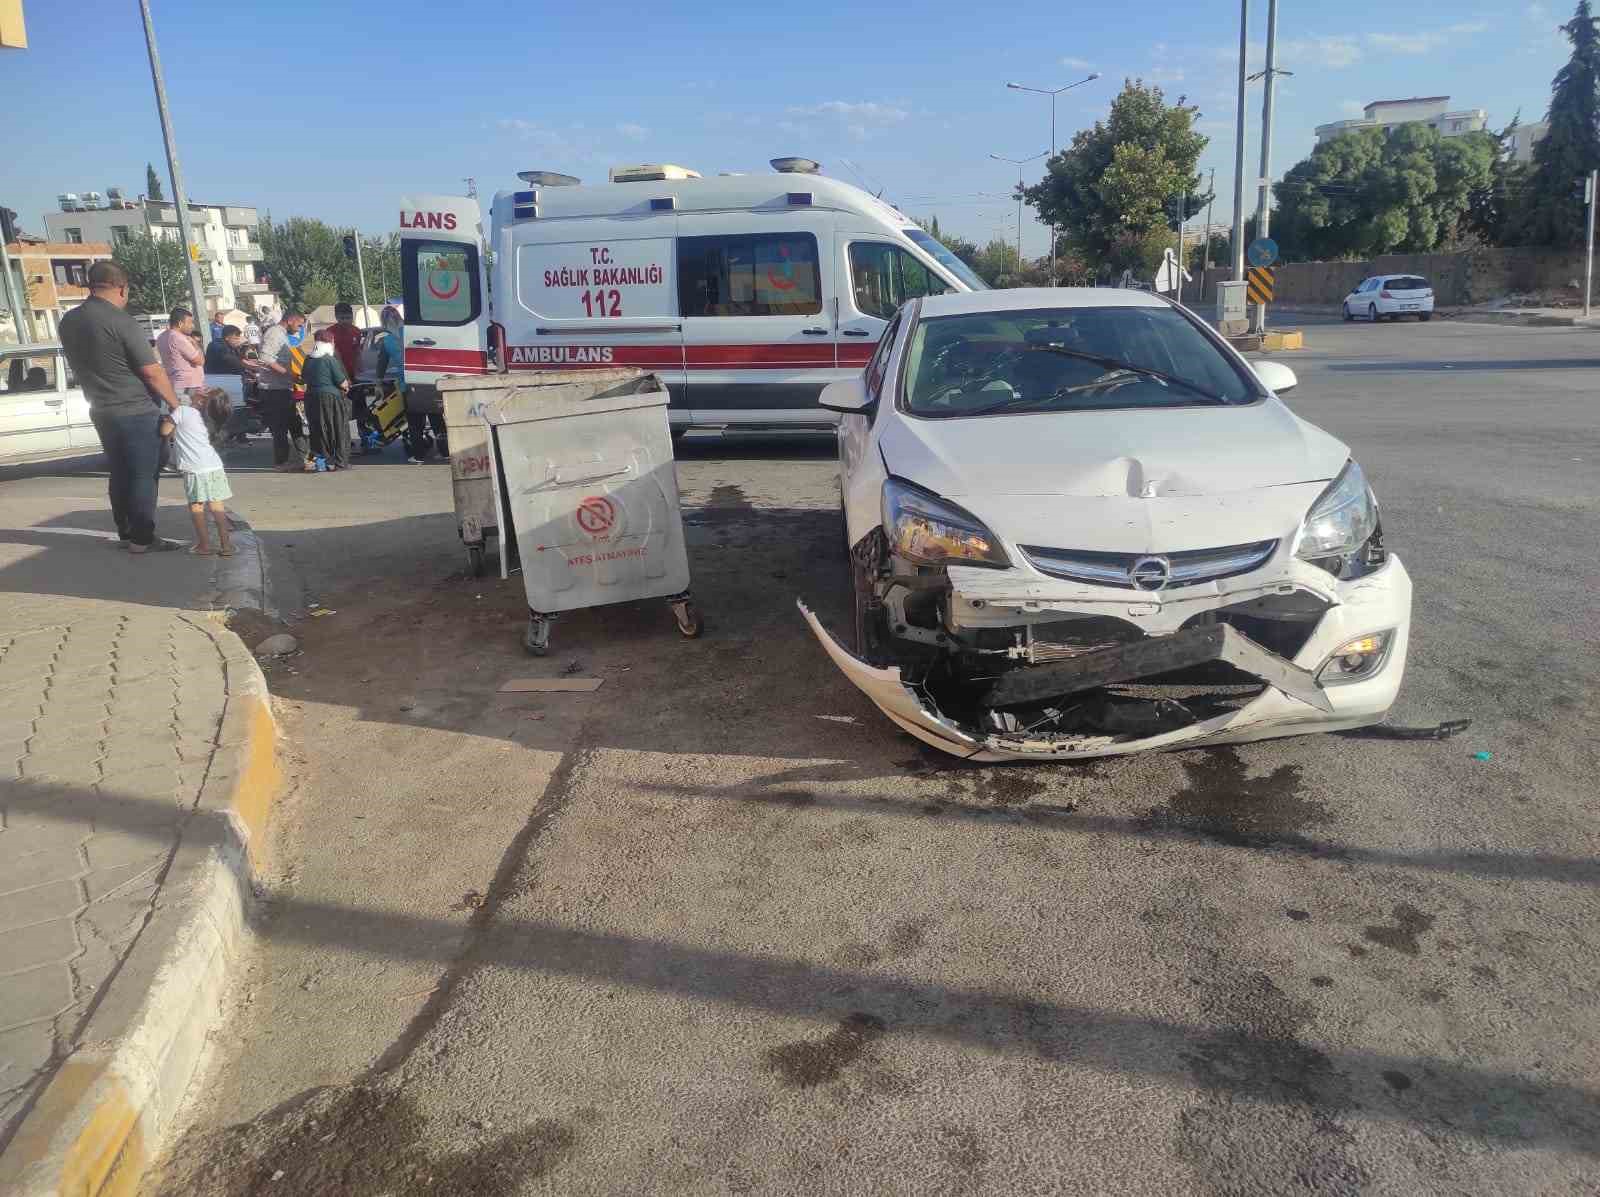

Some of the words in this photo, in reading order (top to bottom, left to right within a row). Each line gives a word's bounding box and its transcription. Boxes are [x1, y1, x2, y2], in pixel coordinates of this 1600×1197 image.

[400, 210, 457, 231] LANS
[590, 247, 614, 265] T.C.
[544, 266, 589, 287] SAĞLIK
[593, 263, 663, 286] BAKANLIĞI
[581, 289, 622, 318] 112
[511, 346, 614, 363] AMBULANS
